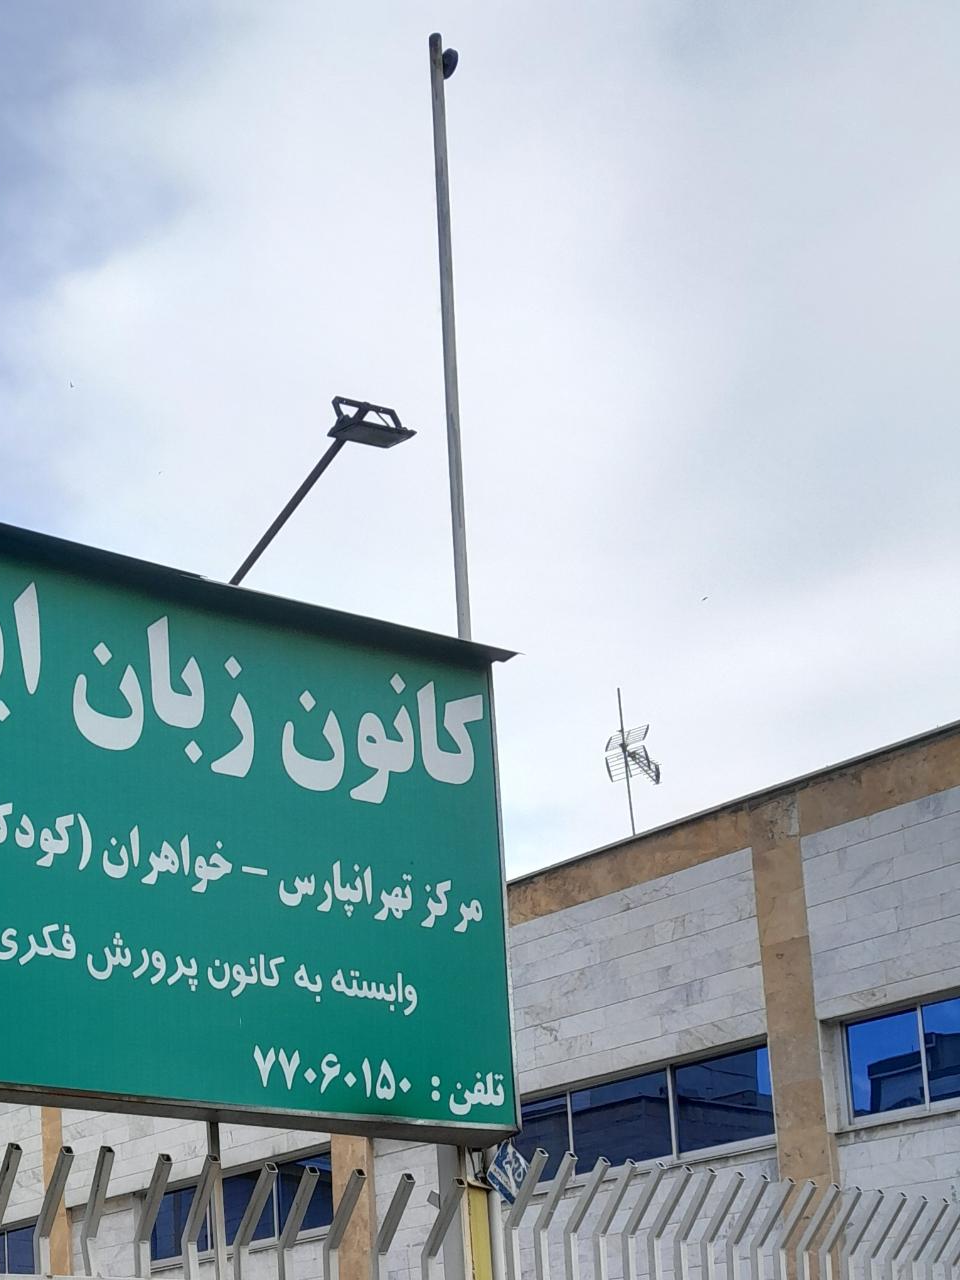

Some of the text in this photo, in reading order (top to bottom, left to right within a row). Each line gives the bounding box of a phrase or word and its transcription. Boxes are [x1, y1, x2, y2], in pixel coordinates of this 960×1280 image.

[72, 615, 255, 778] زبان
[281, 673, 484, 804] کانون
[102, 825, 233, 894] خواهران
[278, 860, 413, 921] تهرانپارس
[420, 875, 483, 933] مرکز
[86, 931, 198, 991] پرورش
[207, 953, 285, 998] کانون
[293, 963, 323, 1003] به
[330, 964, 418, 1016] وابسته
[252, 1045, 411, 1101] ۷۷۰۶۰۱۵۰
